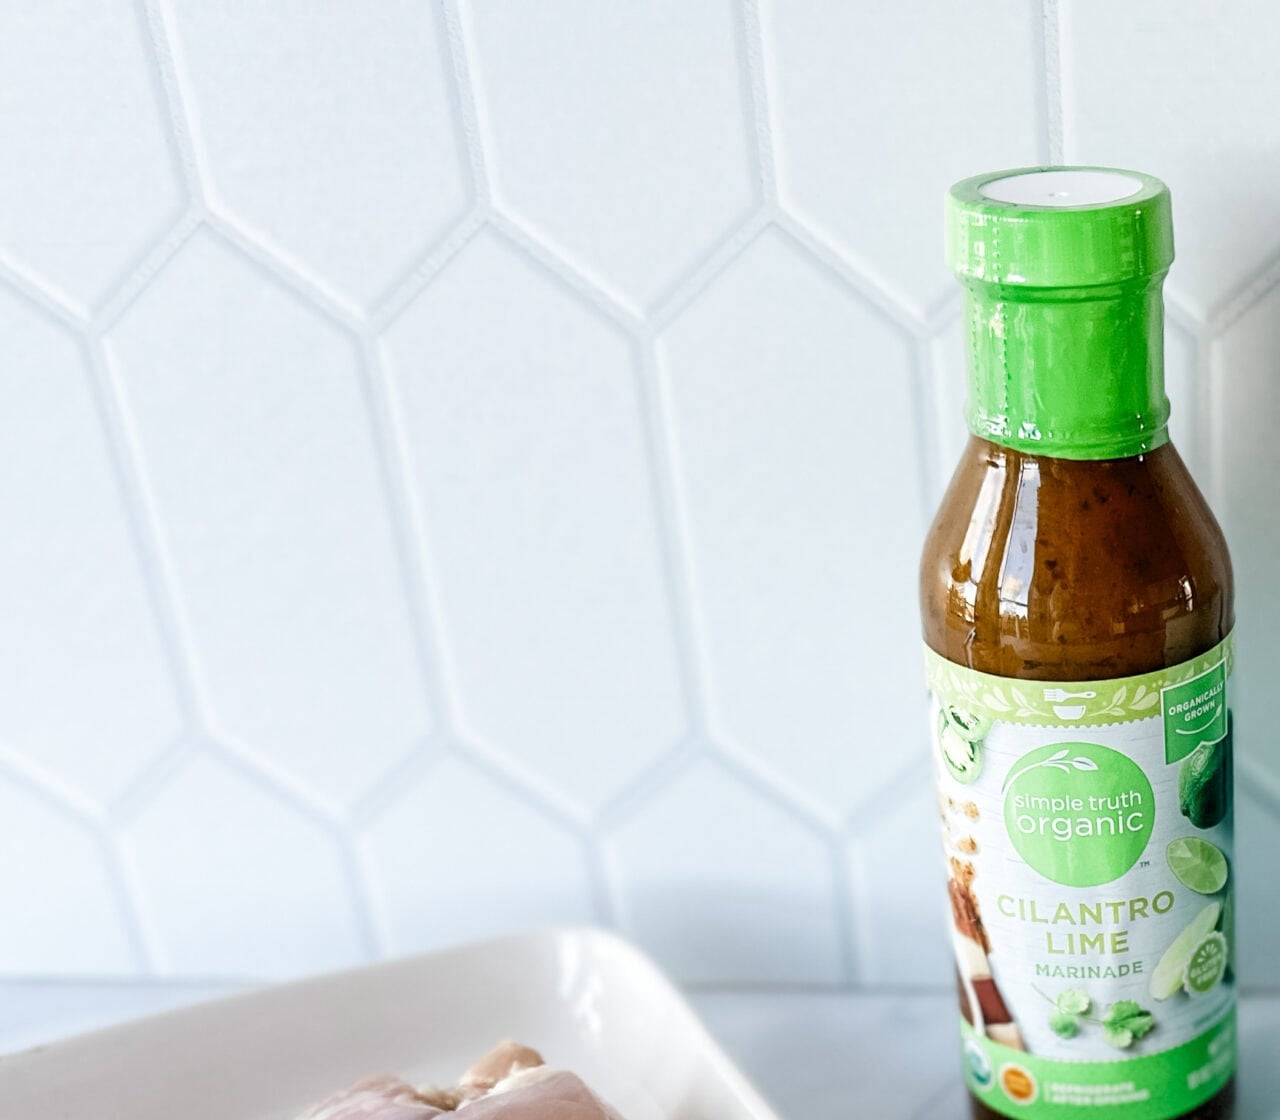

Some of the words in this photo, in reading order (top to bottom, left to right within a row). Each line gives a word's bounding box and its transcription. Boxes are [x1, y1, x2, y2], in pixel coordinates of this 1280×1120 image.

[1168, 681, 1224, 716] ORGANICALLY
[1184, 700, 1215, 721] GROWN
[1014, 793, 1084, 814] simple
[1089, 790, 1142, 811] truth
[1016, 810, 1144, 841] organic
[996, 890, 1176, 925] CILANTRO
[1046, 930, 1130, 955] LIME
[1035, 960, 1143, 979] MARINADE
